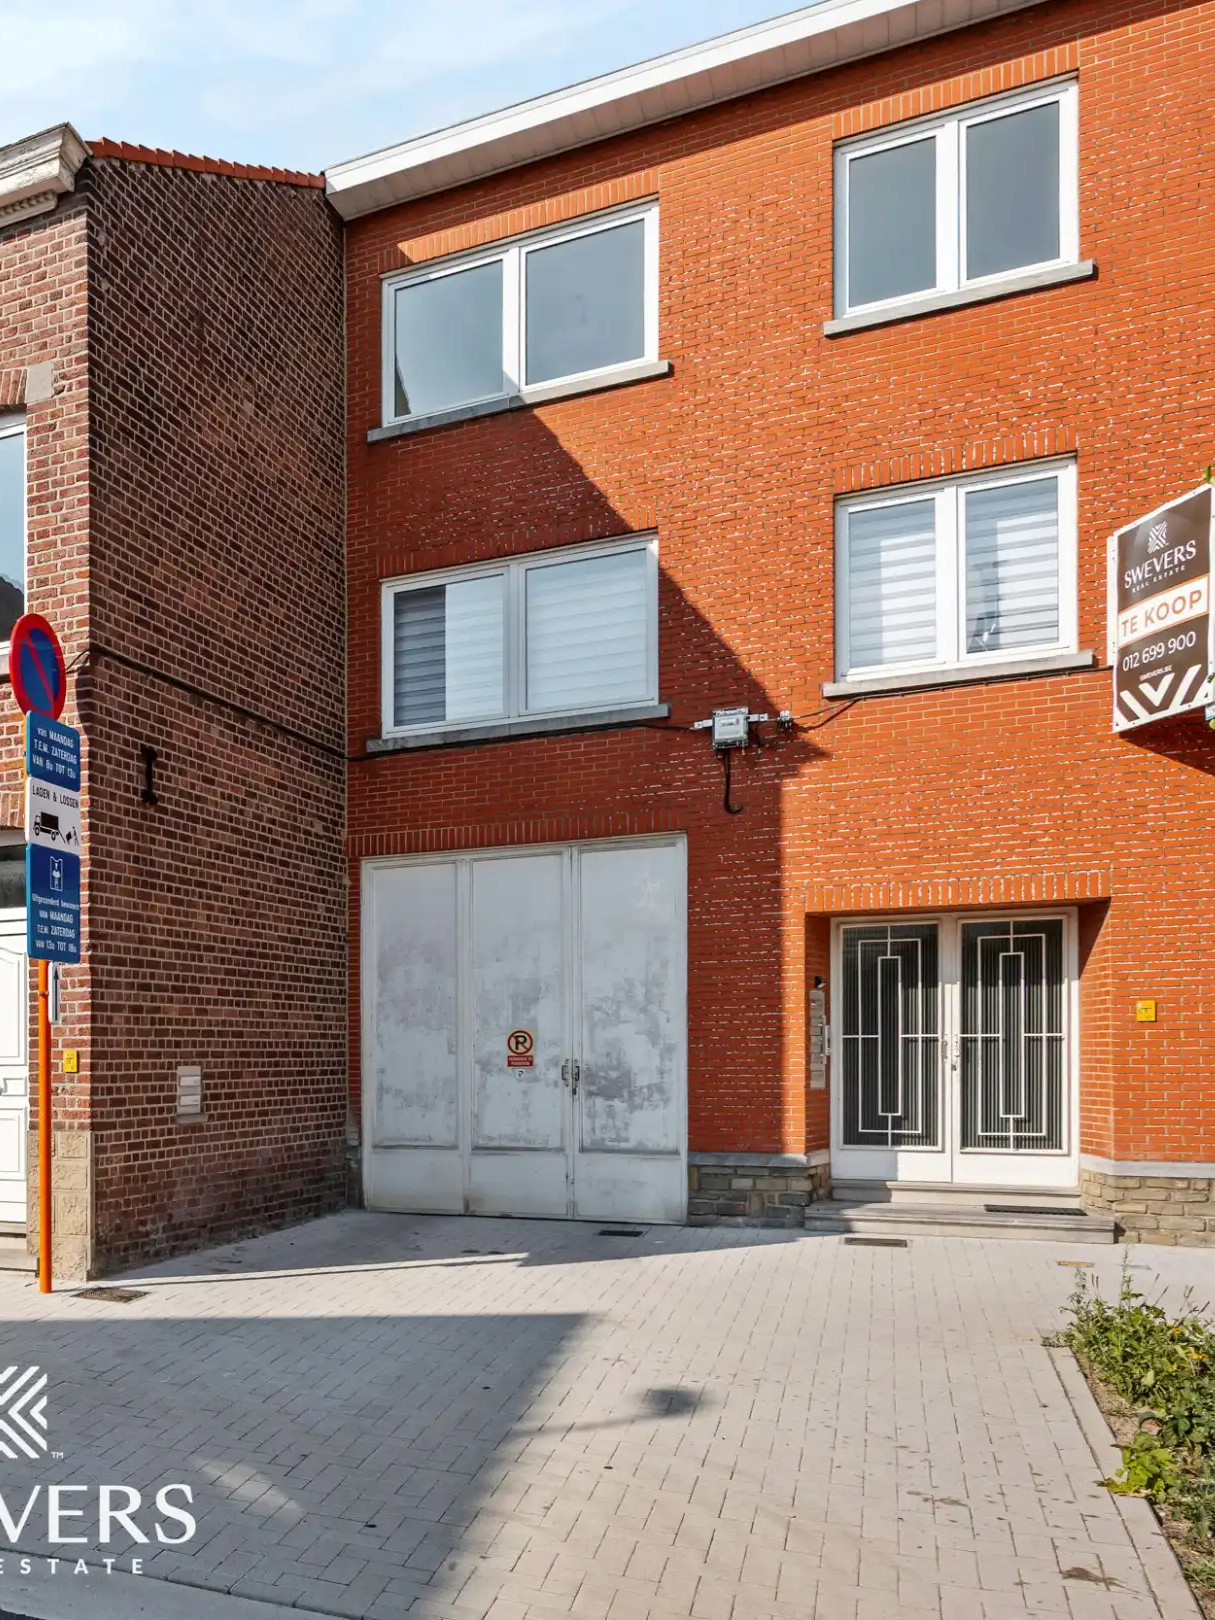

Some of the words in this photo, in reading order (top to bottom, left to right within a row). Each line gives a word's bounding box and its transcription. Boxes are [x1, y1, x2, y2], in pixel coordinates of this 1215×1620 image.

[1124, 540, 1196, 590] SWEVERS
[1131, 580, 1150, 594] REAL
[1152, 564, 1186, 584] ESTATE
[1121, 614, 1138, 637] TE
[1144, 589, 1203, 624] KOOP
[1122, 652, 1139, 672] 012
[1142, 642, 1164, 664] 699
[1168, 631, 1196, 653] 900
[49, 730, 74, 748] MAANDAG
[32, 754, 44, 767] VAN
[55, 763, 65, 775] TOT
[51, 746, 77, 765] ZATERDAG
[32, 785, 50, 800] LADEN
[53, 792, 57, 801] &
[60, 793, 78, 808] LOSSEN
[50, 910, 74, 923] MAANDAG
[50, 926, 76, 938] ZATERDAG
[35, 940, 45, 948] VAN
[57, 941, 66, 951] TOT
